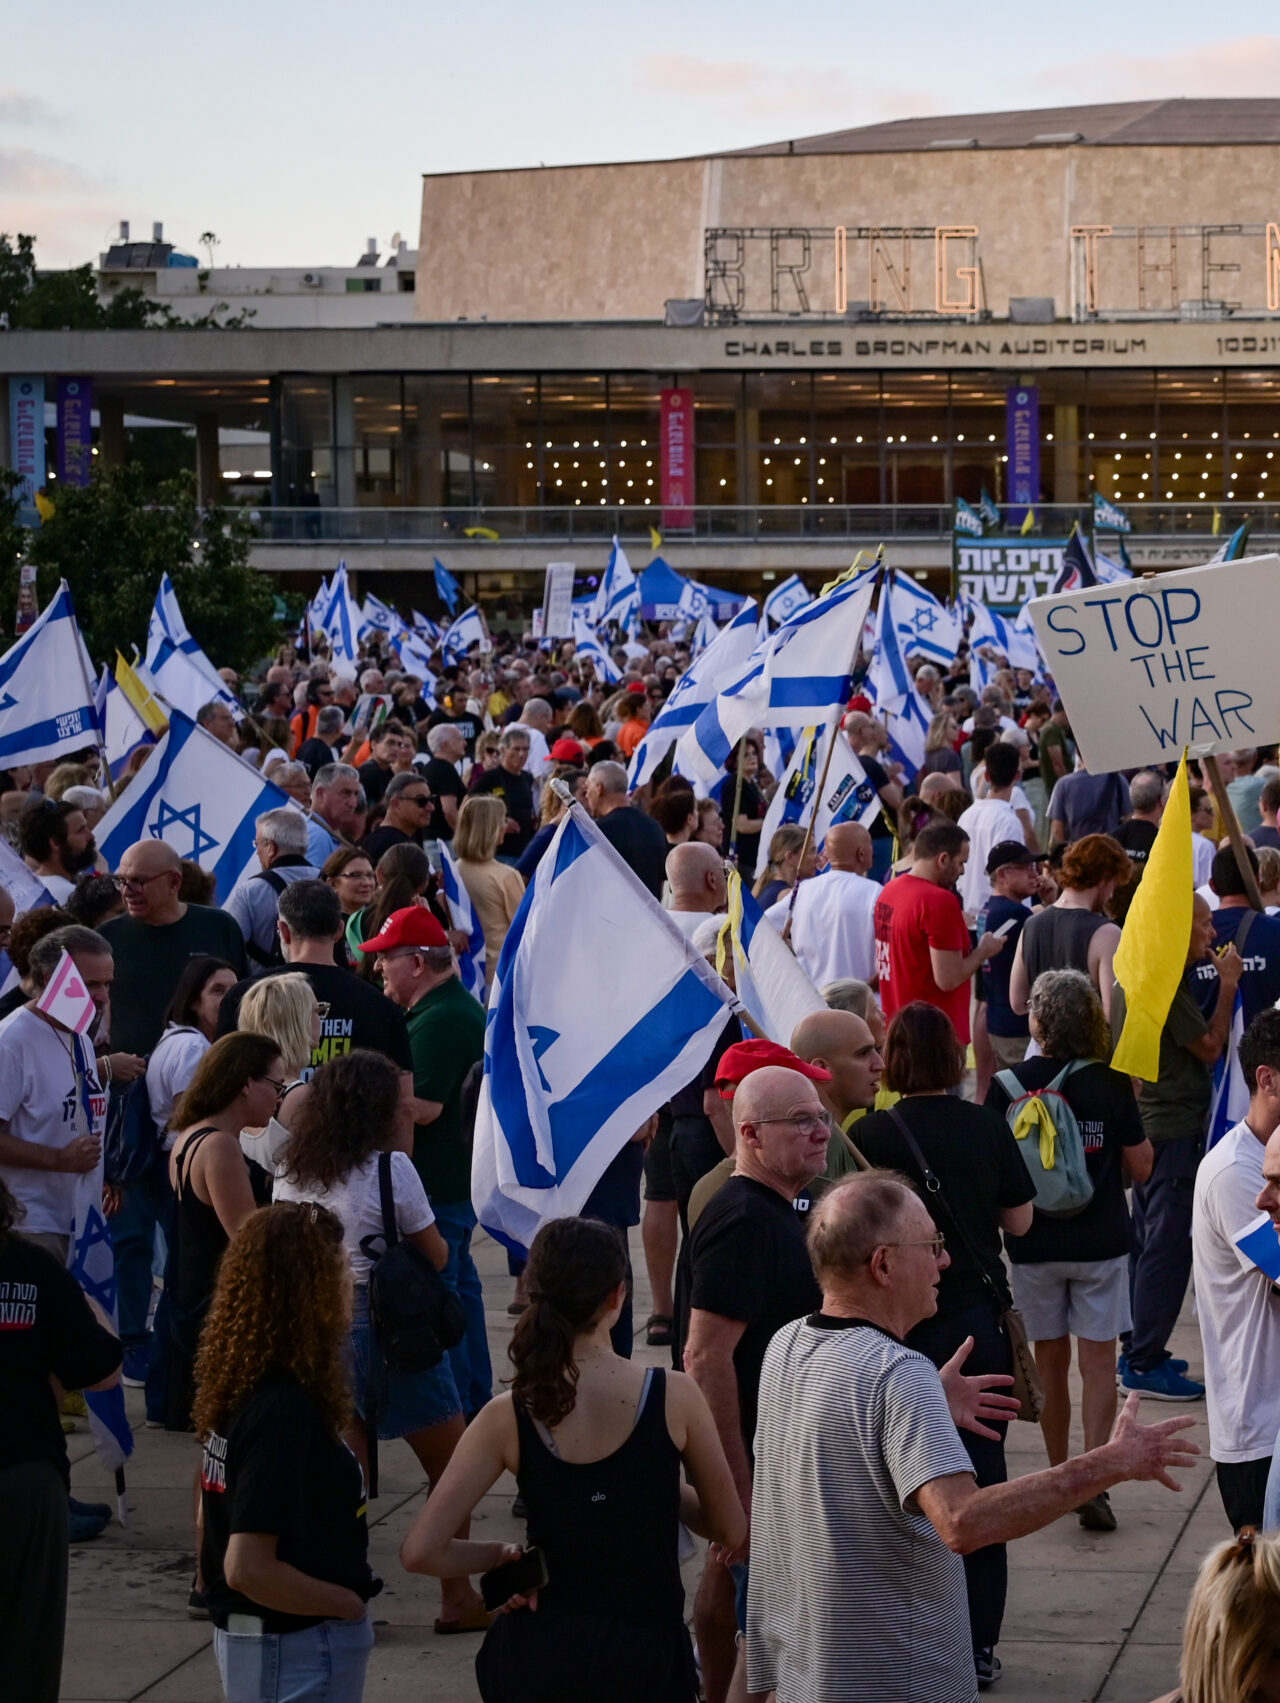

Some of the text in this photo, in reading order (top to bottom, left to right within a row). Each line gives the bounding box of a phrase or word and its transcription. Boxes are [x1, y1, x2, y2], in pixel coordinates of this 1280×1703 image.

[705, 226, 979, 313] BRING
[725, 338, 1146, 356] CHARLES BRONFMAN AUDITORIUM
[957, 547, 1068, 573] חים.יות
[1047, 588, 1201, 656] STOP
[1130, 646, 1216, 688] THE
[1139, 690, 1255, 749] WAR
[591, 1490, 606, 1502] alo
